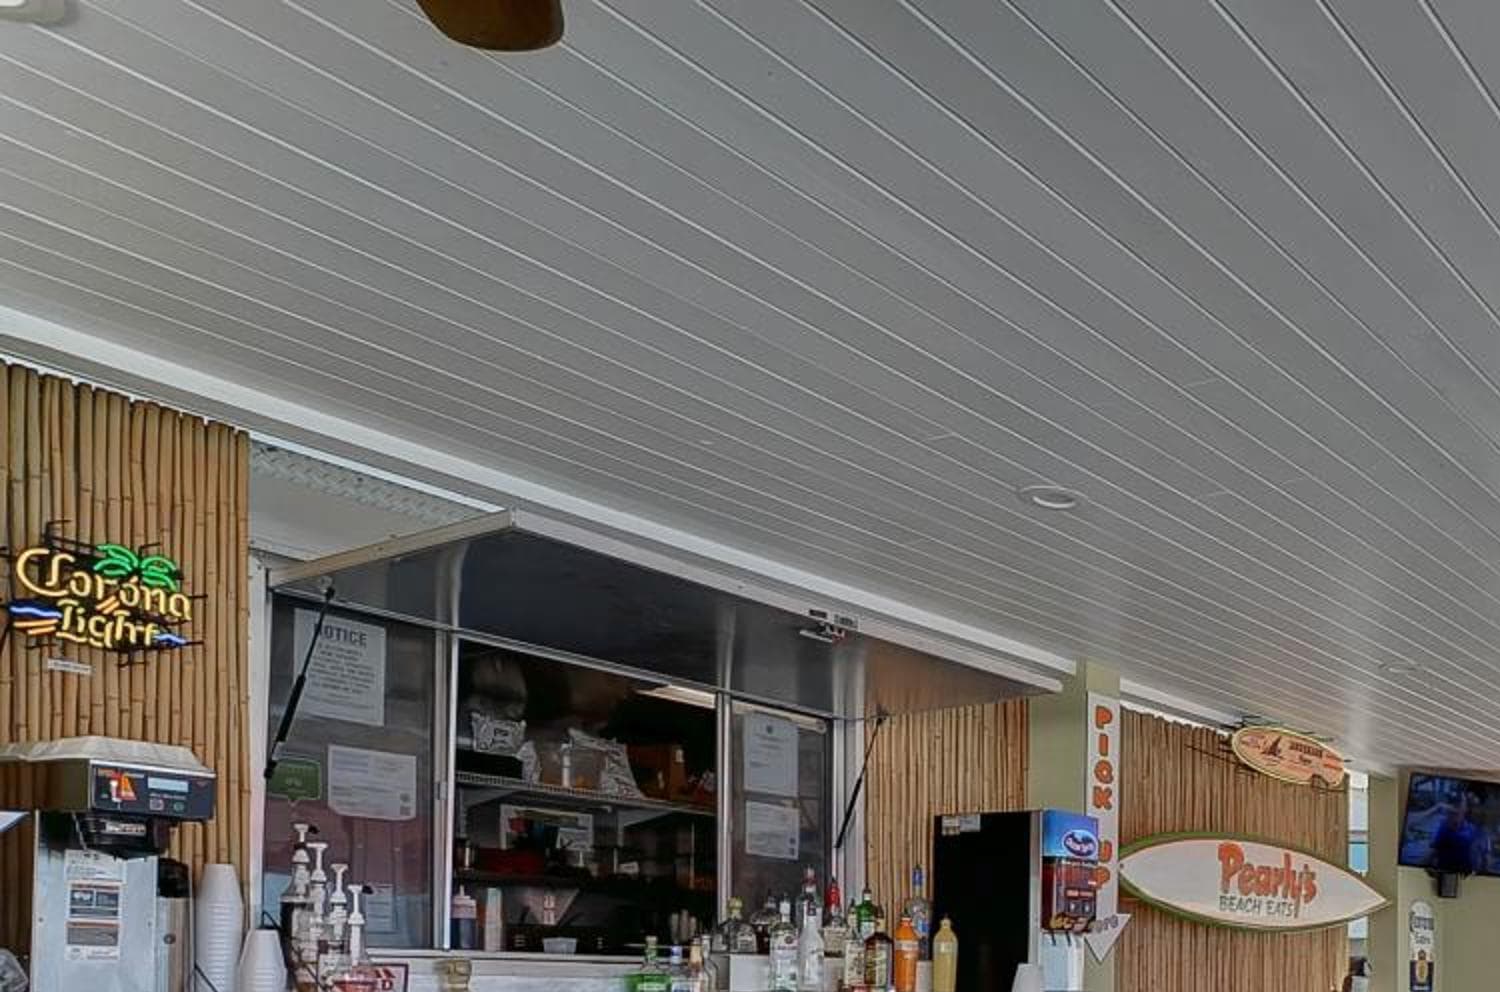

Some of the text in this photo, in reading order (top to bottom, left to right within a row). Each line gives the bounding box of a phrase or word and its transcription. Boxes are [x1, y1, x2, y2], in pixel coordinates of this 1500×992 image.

[16, 548, 192, 621] Corona
[56, 598, 160, 648] Light
[1092, 705, 1114, 890] PICK UP
[1217, 842, 1317, 918] Pearly's
[1219, 895, 1294, 917] BEACH EATS
